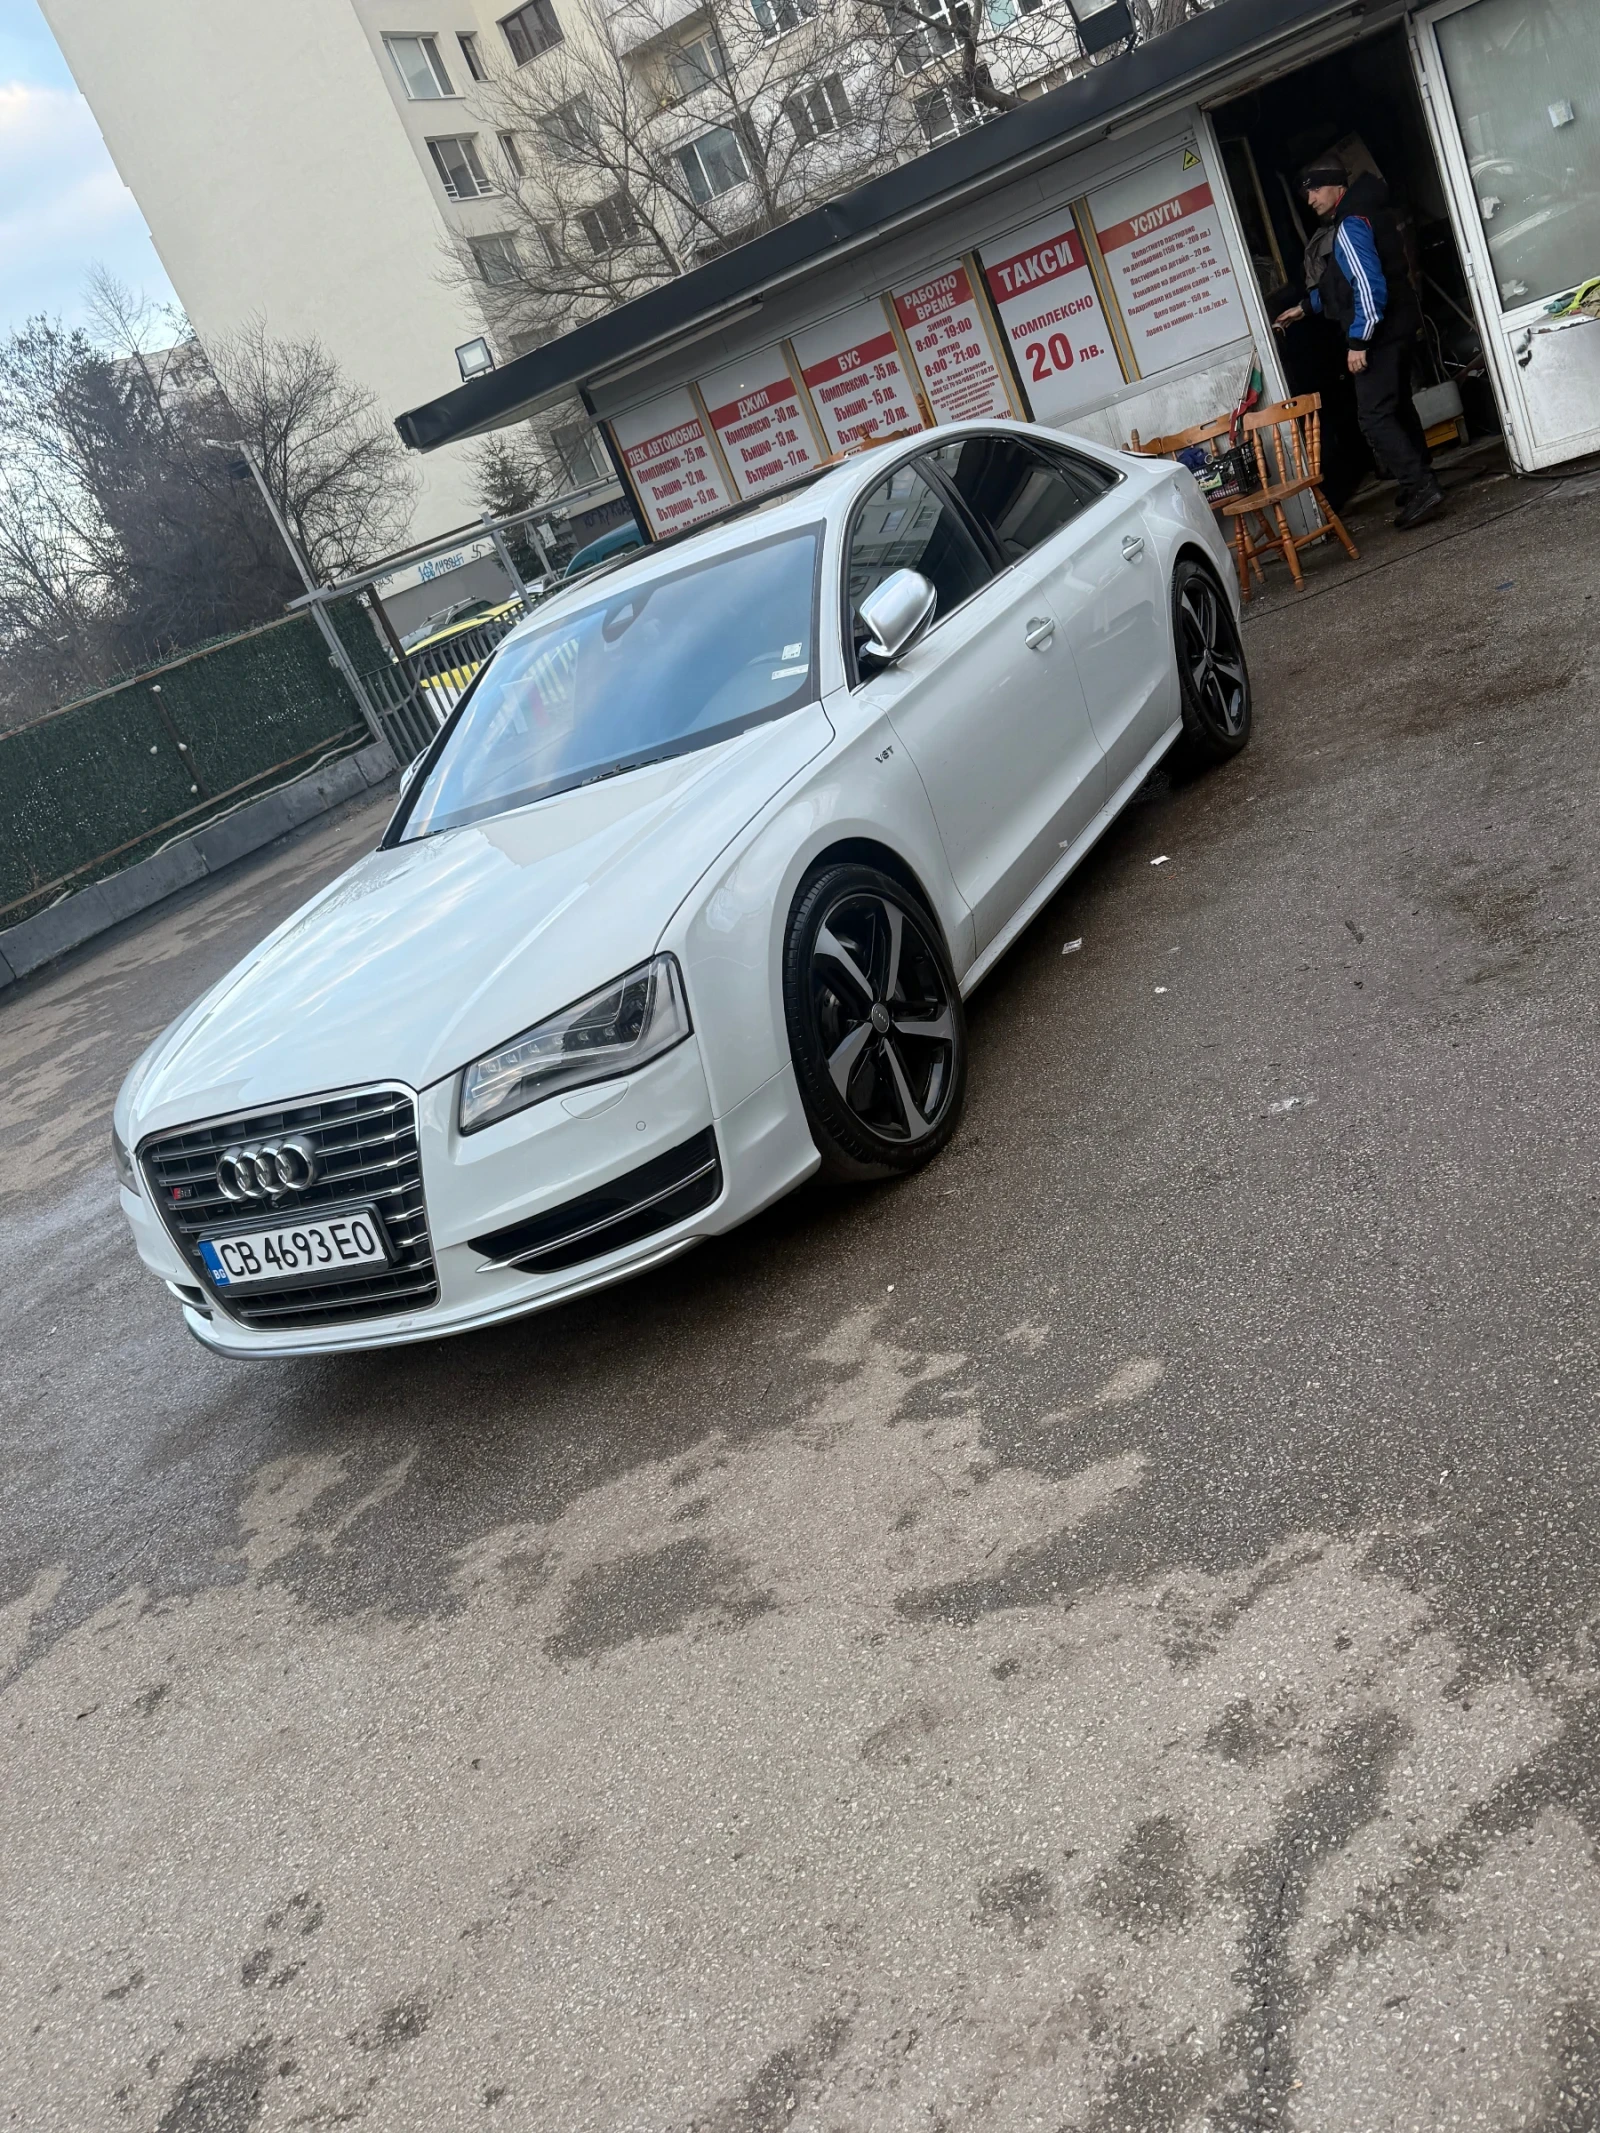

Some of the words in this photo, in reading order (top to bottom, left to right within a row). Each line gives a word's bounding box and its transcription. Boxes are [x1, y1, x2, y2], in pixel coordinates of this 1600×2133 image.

[1129, 199, 1181, 236] УСЛУГИ
[1187, 233, 1199, 244] 200
[998, 241, 1073, 291] ТАКСИ
[1160, 278, 1168, 286] на
[1168, 266, 1196, 283] двигател
[1199, 260, 1207, 268] 15
[1207, 257, 1217, 266] лв.
[1168, 254, 1189, 269] детайл
[1193, 247, 1201, 257] 20
[1201, 245, 1211, 253] лв.
[903, 275, 956, 308] РАБОТНО
[1171, 283, 1191, 296] кожен
[1213, 269, 1221, 277] 15
[1221, 266, 1231, 275] лв.
[916, 292, 955, 320] ВРЕМЕ
[1011, 295, 1092, 339] КОМПЛЕКСНО
[1168, 300, 1186, 312] пране
[1190, 292, 1201, 302] 150
[1201, 290, 1211, 298] лв.
[915, 332, 938, 352] 8:00
[943, 317, 972, 338] 19:00
[926, 315, 952, 332] ЗИМНО
[1170, 312, 1194, 326] килими
[837, 350, 860, 371] БУС
[924, 358, 947, 377] 8:00
[952, 343, 980, 364] 21:00
[936, 341, 960, 357] ЛЯТНО
[1025, 332, 1073, 381] 20
[1079, 344, 1104, 362] лв.
[818, 373, 869, 403] Комплексно
[873, 363, 886, 380] 35
[885, 360, 900, 376] лв.
[737, 391, 771, 419] ДЖИП
[833, 398, 867, 421] Външно
[871, 388, 883, 405] 15
[882, 386, 896, 401] лв.
[882, 408, 895, 425] 20
[894, 406, 909, 421] лв.
[724, 416, 770, 445] Комплексно
[774, 406, 786, 423] 30
[785, 404, 799, 419] лв.
[627, 447, 647, 465] ЛЕК
[647, 422, 701, 456] АВТОМОБИЛ
[740, 439, 771, 462] Външно
[775, 431, 786, 446] 13
[784, 429, 798, 443] лв.
[636, 456, 680, 483] Комплексно
[683, 447, 695, 463] 25
[693, 445, 707, 459] лв.
[744, 458, 783, 484] Вътрешно
[787, 450, 796, 465] 17
[795, 448, 809, 463] лв.
[651, 479, 682, 500] Външно
[685, 470, 696, 485] 12
[693, 469, 707, 483] лв.
[655, 497, 693, 521] Вътрешно
[696, 489, 707, 504] 13
[705, 487, 718, 501] лв.
[213, 1269, 226, 1280] BG
